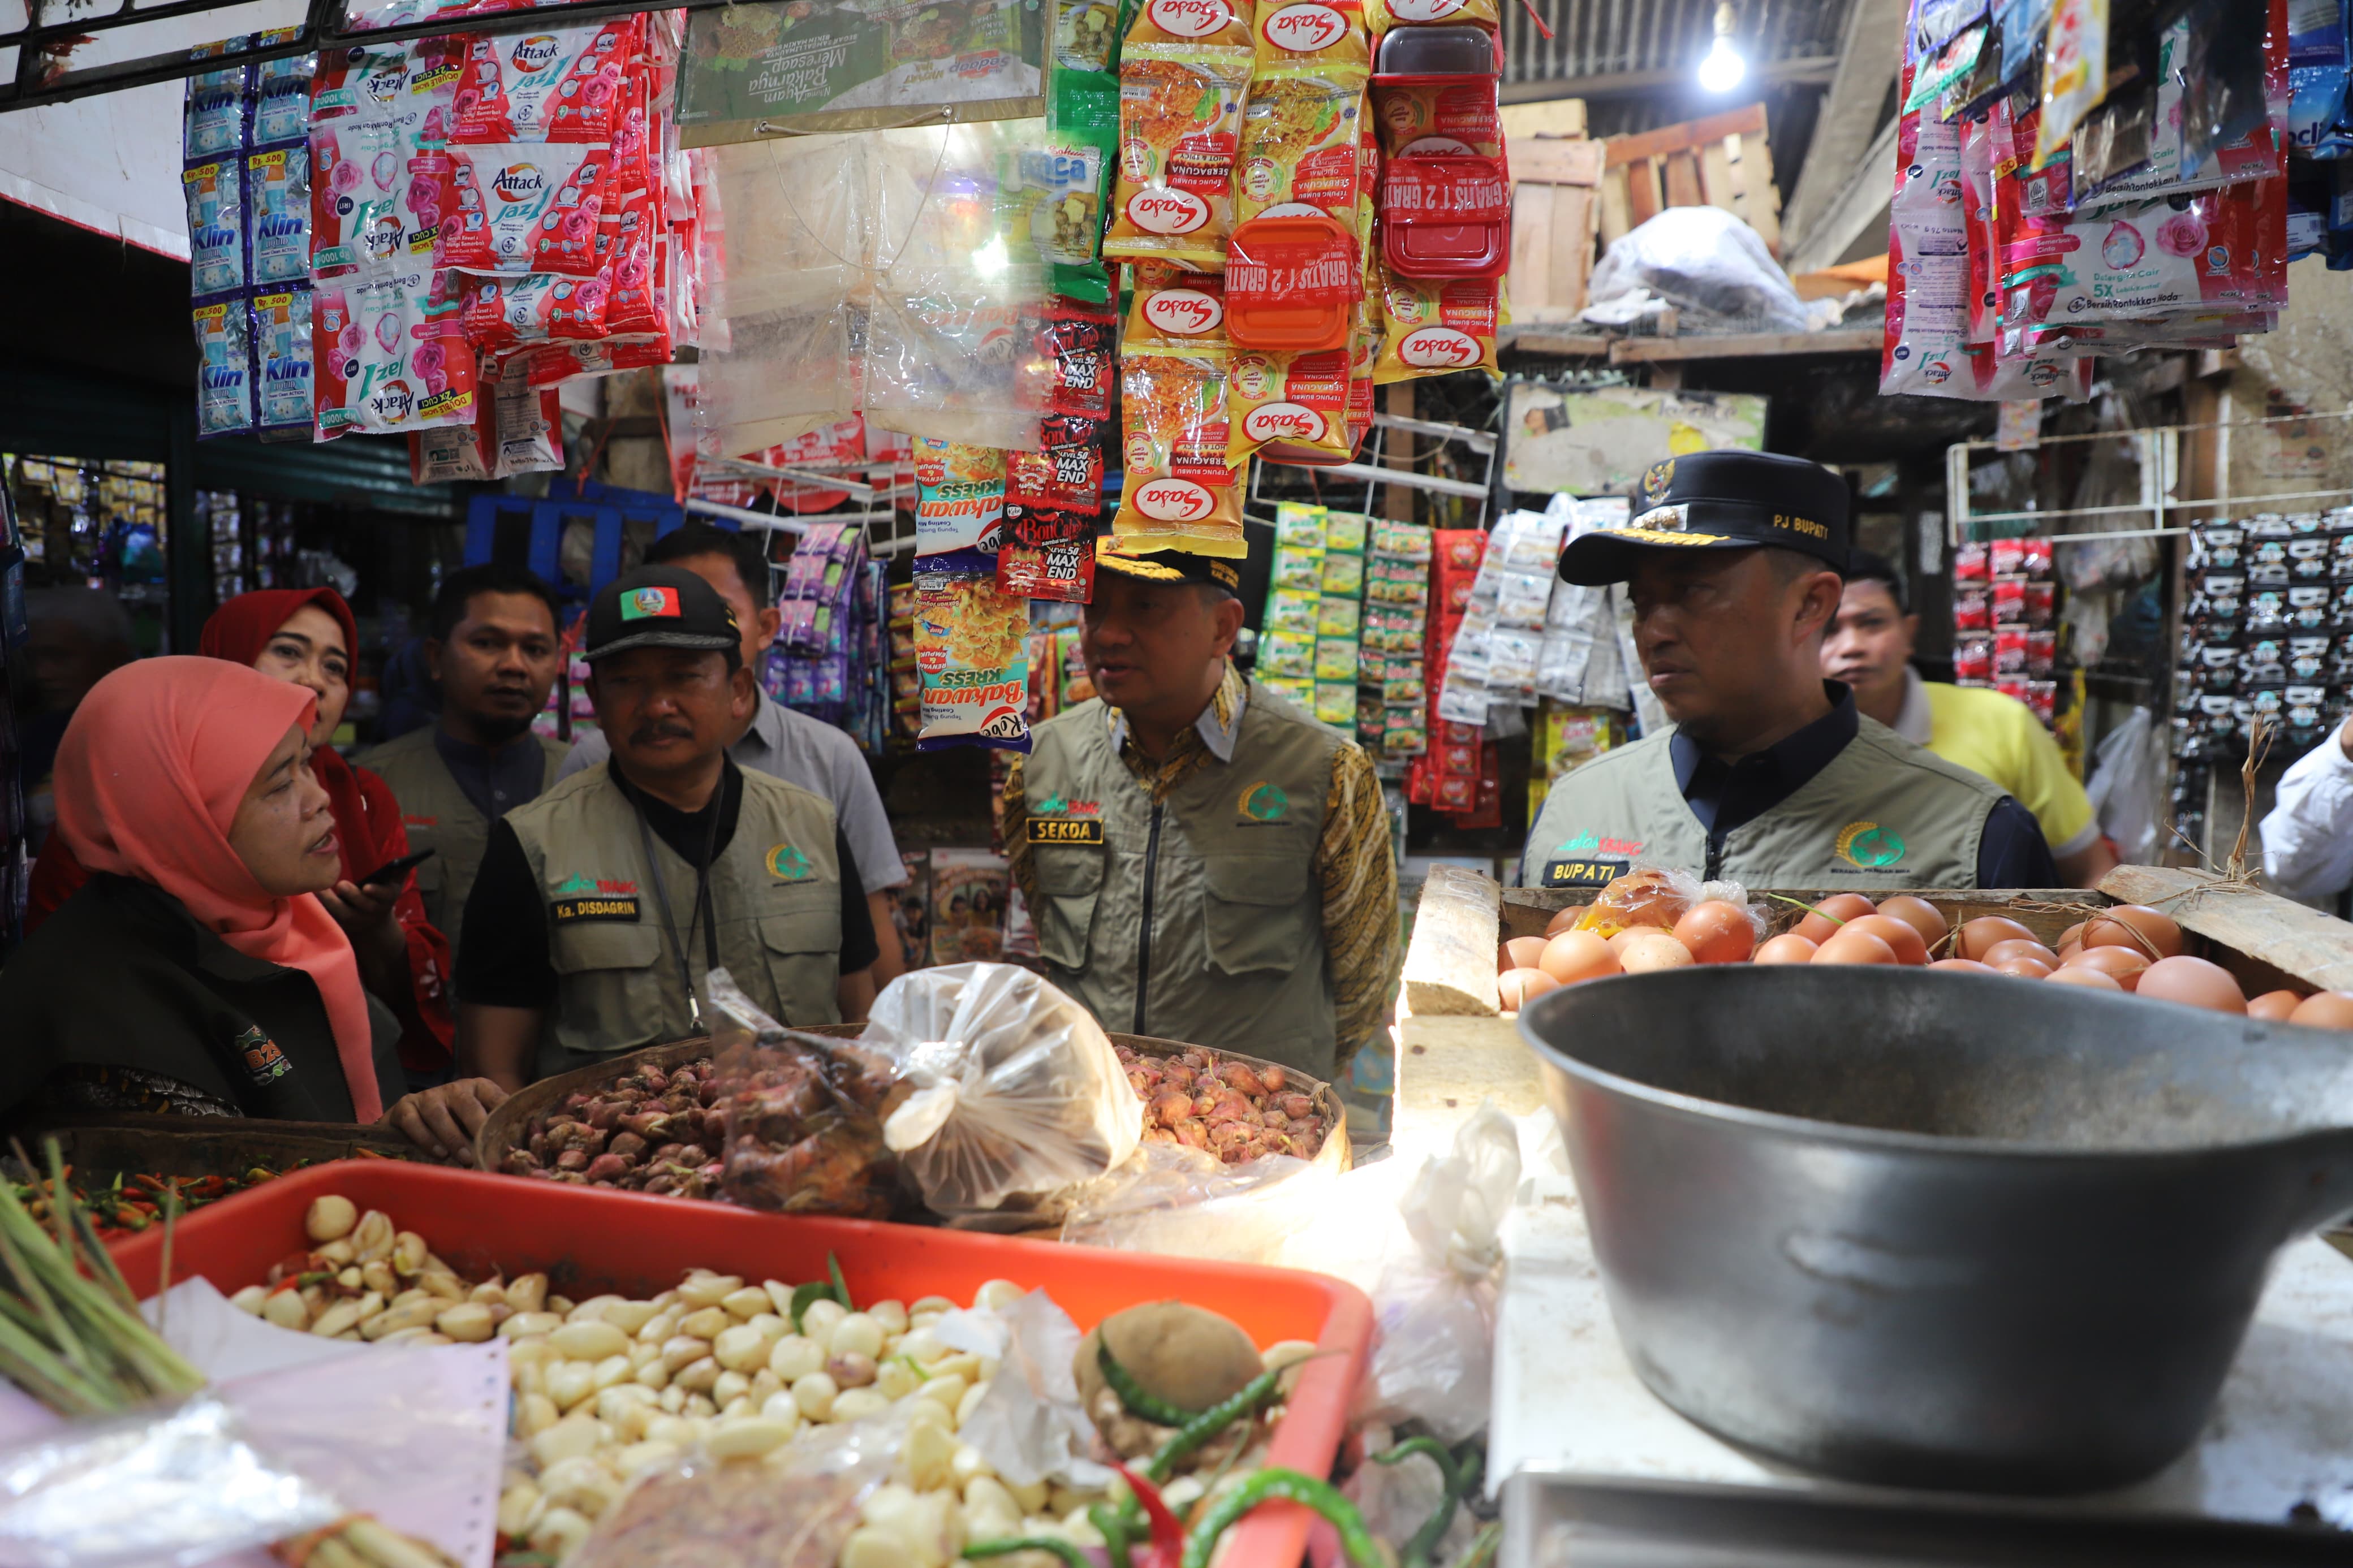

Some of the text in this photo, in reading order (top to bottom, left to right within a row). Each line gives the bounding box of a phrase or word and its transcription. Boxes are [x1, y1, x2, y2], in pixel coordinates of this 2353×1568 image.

[1159, 0, 1219, 31] Sasa
[1273, 12, 1335, 45] Sasa
[511, 40, 561, 61] Attack
[772, 47, 847, 74] Meresaap
[949, 56, 1011, 72] Sedaap
[415, 71, 433, 81] CUCI
[430, 71, 459, 84] DOUBLE
[748, 63, 829, 92] Bakarnya
[339, 91, 352, 102] Rp
[764, 83, 811, 103] Ayam
[1441, 114, 1496, 124] SERBAGUNA
[265, 153, 282, 163] 500
[2153, 149, 2176, 160] Cair
[199, 166, 216, 176] 500
[1172, 164, 1229, 176] SERBAGUNA
[492, 167, 544, 190] Attack
[1298, 178, 1350, 190] SERBAGUNA
[1937, 187, 1964, 201] Attack
[2105, 183, 2133, 193] Bersih
[1425, 182, 1503, 211] GRATIS 1 2
[1136, 198, 1198, 229] Sasa
[258, 211, 305, 241] Klin
[193, 223, 236, 250] Klin
[412, 230, 429, 241] CUCI
[2037, 238, 2071, 247] Semerbak
[340, 251, 351, 261] Rp
[1271, 267, 1283, 293] 2
[1298, 260, 1348, 289] GRATIS
[2137, 268, 2160, 278] Cair
[2093, 284, 2114, 298] 5X
[270, 296, 287, 305] 500
[2087, 299, 2113, 309] Bersih
[207, 306, 222, 314] 500
[1153, 298, 1213, 329] Sasa
[1445, 309, 1496, 318] SERBAGUNA
[1408, 338, 1471, 366] Sasa
[1084, 356, 1097, 365] 50
[266, 355, 311, 383] Klin
[1063, 364, 1097, 377] MAX
[1924, 369, 1954, 382] Attack
[202, 364, 244, 390] Klin
[1064, 377, 1094, 390] END
[273, 380, 296, 391] LIQUID
[1291, 383, 1344, 392] SERBAGUNA
[421, 396, 439, 407] CUCI
[421, 396, 467, 417] DOUBLE SACHET
[1252, 412, 1314, 435] Sasa
[1076, 451, 1089, 460] 50
[1176, 456, 1226, 466] ERBAGUNA
[1055, 457, 1089, 473] MAX
[1056, 469, 1087, 485] END
[939, 478, 999, 499] KRESS
[920, 495, 1002, 519] akwan
[1143, 488, 1204, 517] Sasa
[1773, 514, 1829, 541] PJ BUPATI
[1067, 546, 1080, 555] 50
[1046, 553, 1080, 568] MAX
[1046, 566, 1078, 580] END
[936, 599, 960, 608] Bakwan
[941, 667, 1002, 686] KRESS
[924, 680, 1025, 707] Bakwan
[1037, 822, 1091, 839] SEKDA
[1553, 863, 1616, 882] BUPATI
[557, 901, 636, 918] Ka. DISDAGRIN
